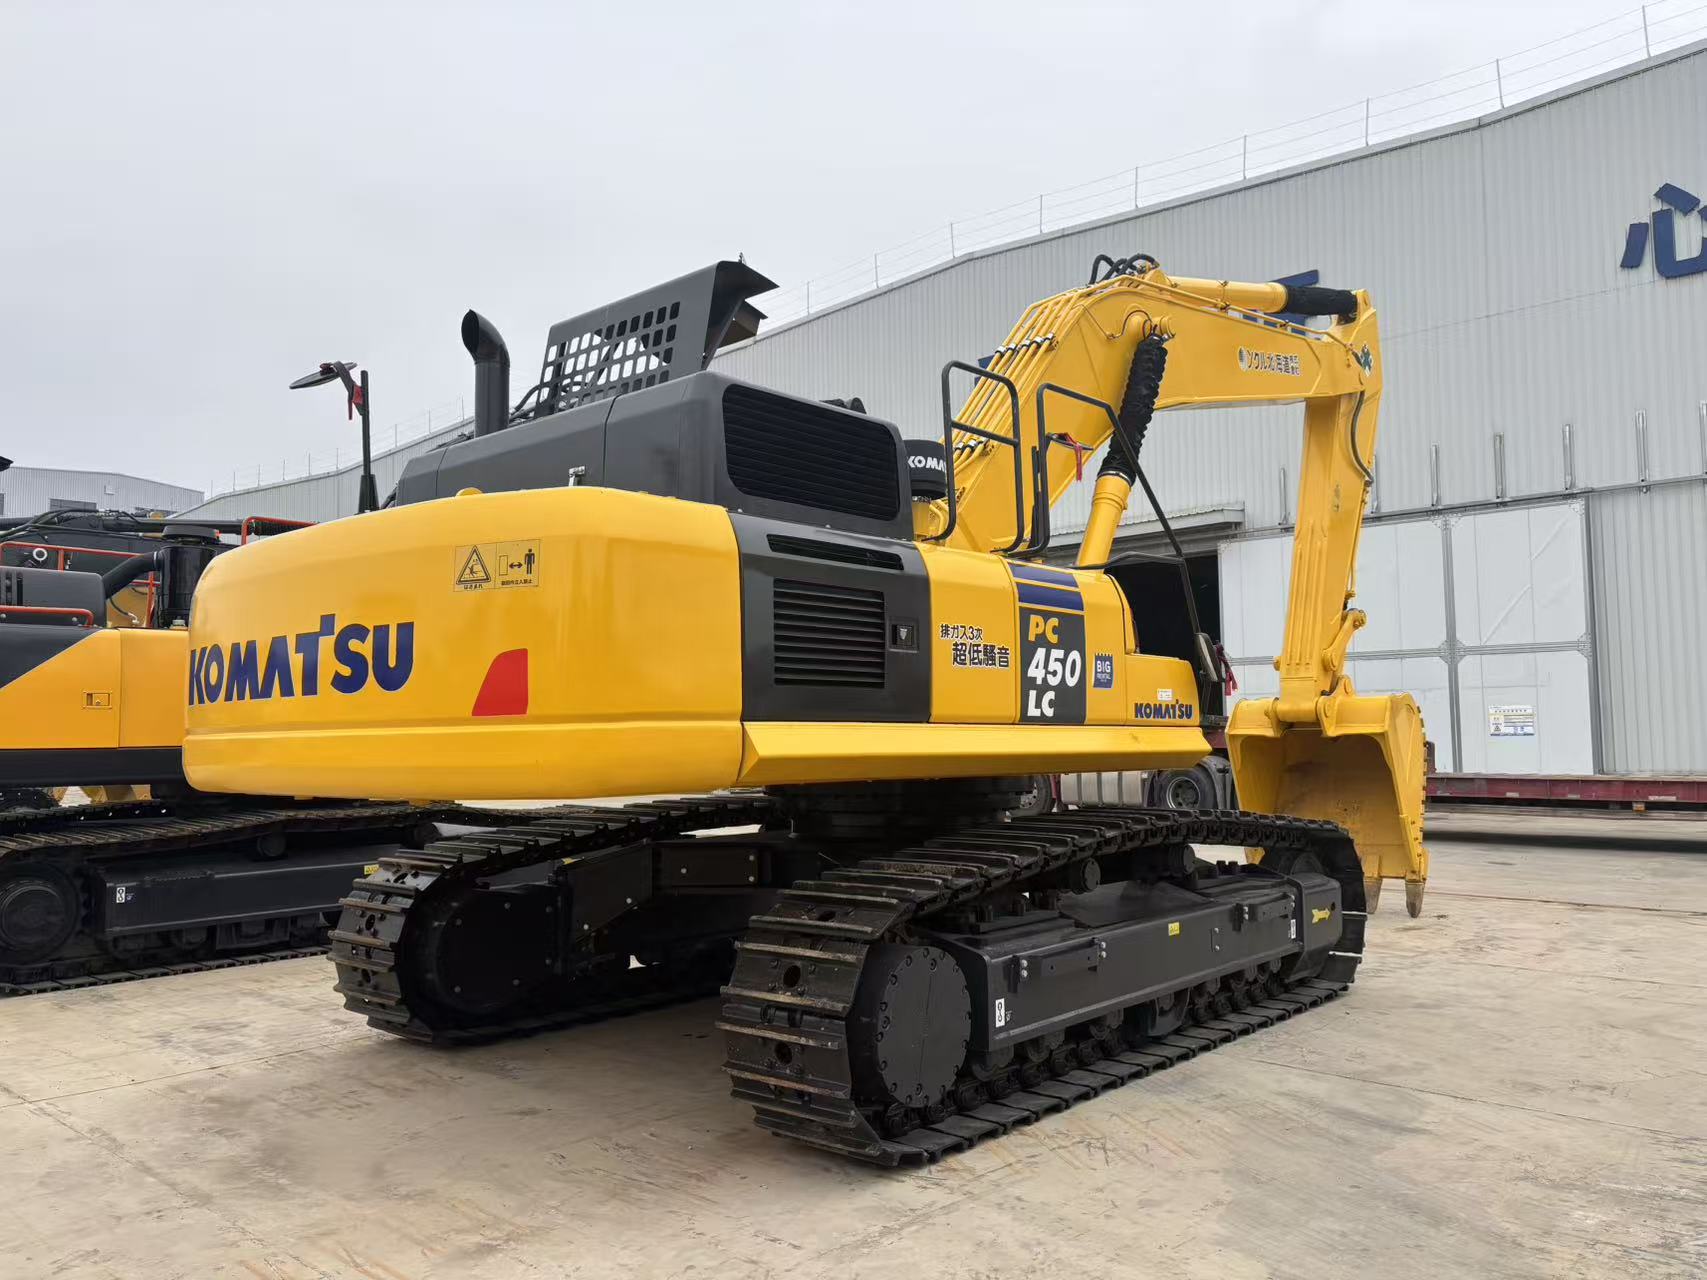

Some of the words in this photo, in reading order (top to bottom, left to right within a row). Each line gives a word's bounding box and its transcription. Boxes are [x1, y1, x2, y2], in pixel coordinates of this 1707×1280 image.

[940, 624, 983, 641] 排ガス3次
[1028, 614, 1060, 644] PC
[189, 613, 414, 706] KOMATSU
[952, 641, 1010, 667] 超低騒音
[1027, 647, 1082, 687] 450
[1096, 660, 1111, 672] BIG
[1027, 689, 1056, 717] LC
[1134, 699, 1193, 719] KOMATSU
